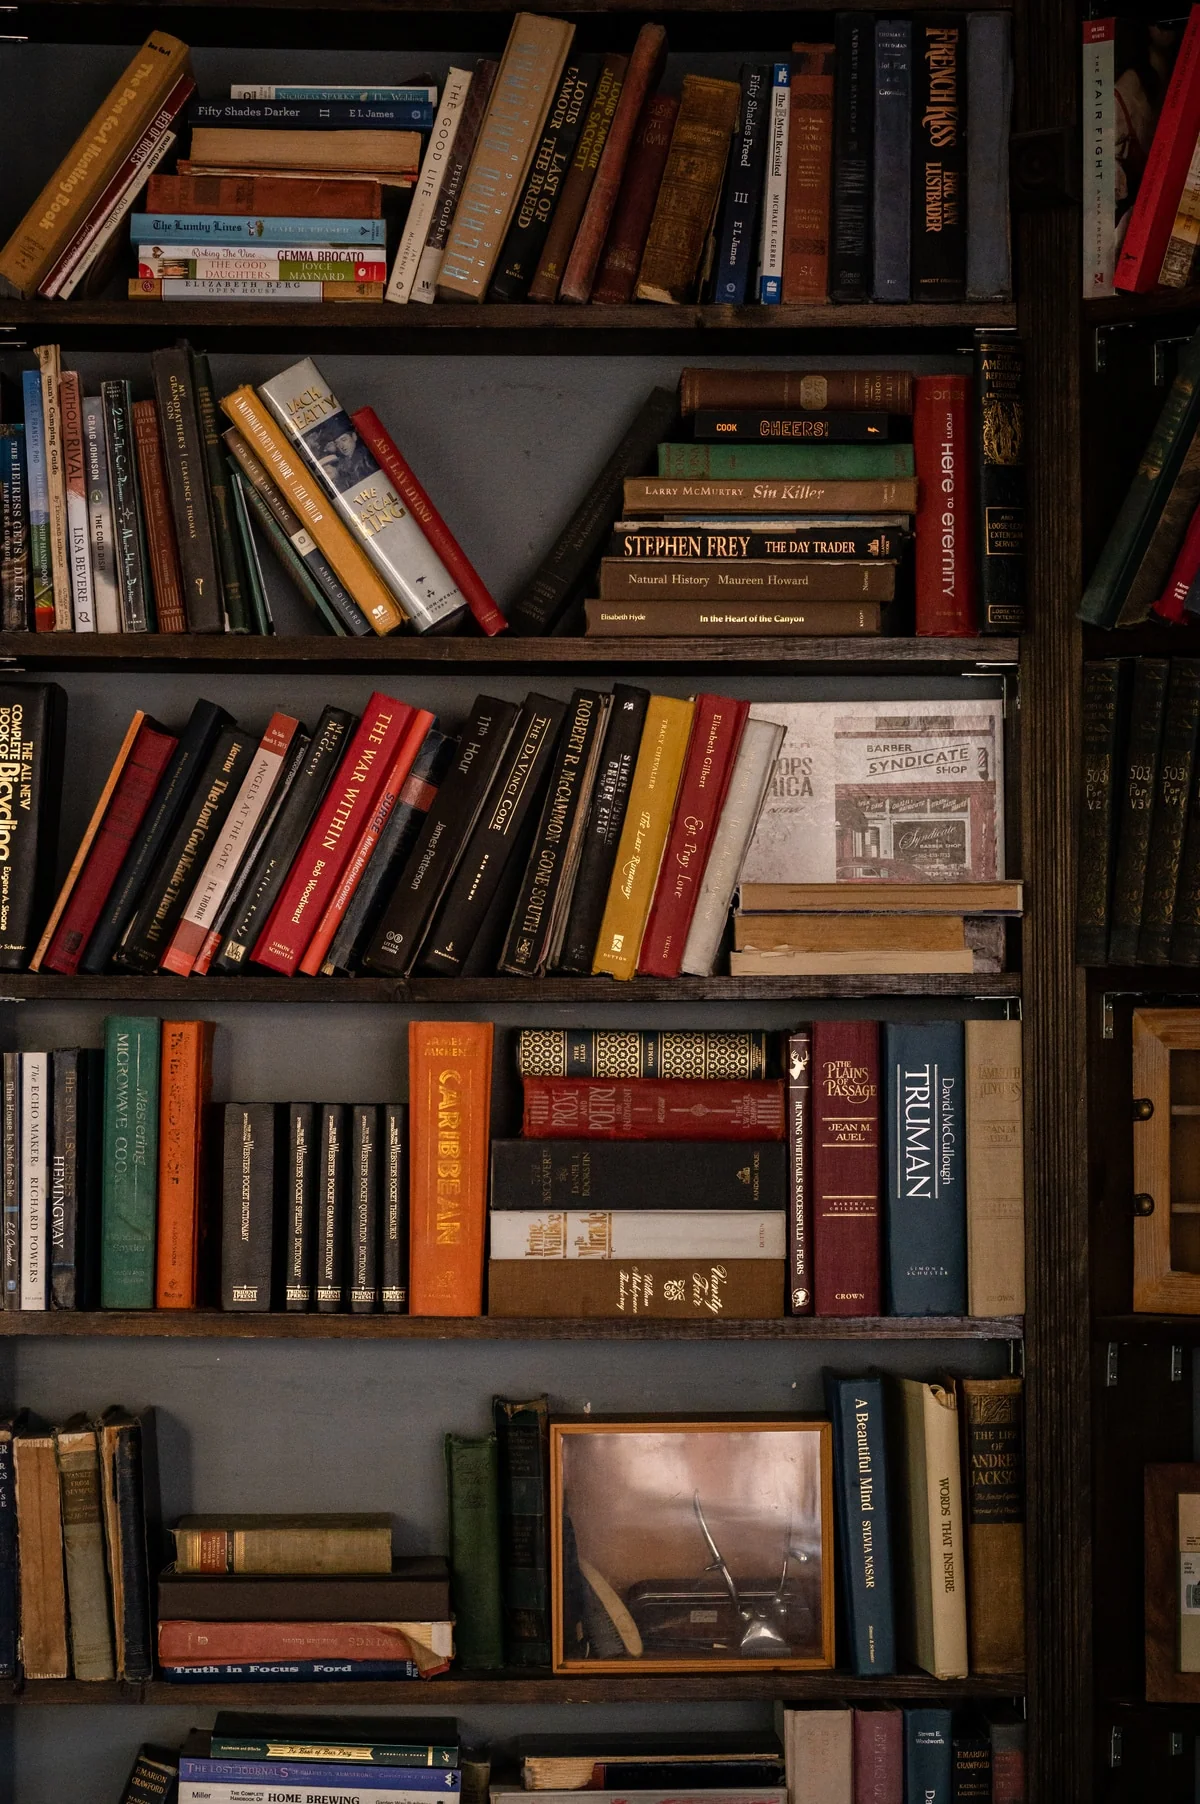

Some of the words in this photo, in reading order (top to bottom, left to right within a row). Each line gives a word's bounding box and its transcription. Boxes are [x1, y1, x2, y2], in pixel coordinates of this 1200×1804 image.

[925, 27, 959, 101] FRENCH
[447, 84, 462, 110] THE
[550, 66, 579, 130] L'AMOUR
[747, 73, 762, 99] Fifty
[198, 106, 223, 119] Fifty
[225, 107, 262, 117] Shades
[264, 107, 300, 118] Darker
[568, 79, 588, 125] LOUIS
[155, 110, 172, 125] BED
[744, 99, 757, 137] Shades
[921, 105, 959, 148] KISS
[150, 126, 162, 142] OF
[432, 117, 452, 161] GOOD
[131, 141, 153, 166] ROSES
[536, 136, 551, 171] THE
[740, 138, 751, 167] Freed
[1095, 128, 1103, 179] FIGHT
[422, 169, 434, 197] LIFE
[548, 151, 567, 192] LAST
[942, 171, 959, 200] ERIC
[516, 173, 541, 229] BREED
[536, 198, 551, 223] OF
[734, 192, 749, 204] III
[925, 162, 943, 233] LUSTBADER
[152, 220, 173, 232] The
[175, 221, 211, 234] Lumby
[213, 221, 242, 232] Lines
[942, 201, 958, 226] VAN
[206, 260, 230, 270] THE
[234, 260, 267, 270] GOOD
[277, 250, 315, 262] GEMMA
[318, 251, 364, 262] BROCATO
[301, 262, 332, 271] JOYCE
[205, 269, 270, 279] DAUGHTERS
[289, 271, 345, 281] MAYNARD
[64, 378, 79, 443] WITHOUT
[237, 401, 262, 434] NATIONAL
[257, 431, 275, 452] PARTY
[270, 450, 282, 462] NO
[276, 459, 294, 480] MORE
[716, 423, 737, 432] COOK
[759, 420, 829, 437] CHEERS!
[67, 446, 82, 482] RIVAL
[12, 456, 21, 515] HEIRESS
[374, 437, 389, 454] AS
[390, 461, 406, 484] LAY
[405, 485, 432, 522] DYING
[645, 486, 680, 496] LARRY
[682, 486, 744, 496] McMURTRY
[752, 485, 778, 499] Sin
[780, 484, 825, 499] Killer
[12, 519, 22, 555] GETS
[73, 527, 84, 550] LISA
[624, 536, 701, 557] STEPHEN
[706, 536, 751, 557] FREY
[765, 541, 786, 553] THE
[789, 541, 811, 553] DAY
[813, 541, 856, 553] TRADER
[14, 566, 24, 601] DUKE
[74, 552, 87, 602] BEVERE
[628, 574, 667, 584] Natural
[671, 574, 710, 587] History
[718, 575, 764, 585] Maureen
[767, 575, 809, 585] Howard
[700, 615, 708, 623] In
[710, 615, 723, 623] the
[725, 615, 748, 623] Heart
[749, 615, 758, 623] of
[759, 615, 772, 623] the
[774, 615, 805, 625] Canyon
[11, 704, 22, 758] COMPLETE
[368, 712, 393, 744] THE
[529, 717, 546, 741] THE
[568, 698, 593, 753] ROBERT
[564, 753, 580, 766] R.
[866, 744, 912, 752] BARBER
[869, 748, 969, 774] SYNDICATE
[22, 763, 32, 781] ALL
[247, 760, 268, 800] ANGELS
[351, 750, 378, 783] WAR
[509, 762, 529, 796] VINCI
[936, 766, 967, 774] SHOP
[1087, 769, 1107, 784] 503
[1129, 765, 1151, 781] 503
[1163, 765, 1185, 781] 503
[20, 784, 31, 811] NEW
[240, 804, 250, 817] AT
[546, 768, 576, 844] McCAMMON
[229, 819, 244, 840] THE
[322, 787, 361, 851] WITHIN
[492, 799, 513, 832] CODE
[639, 811, 651, 829] The
[634, 829, 648, 851] Last
[899, 826, 956, 850] Syndicate
[216, 844, 233, 870] GATE
[312, 859, 326, 877] Bob
[535, 849, 557, 884] GONE
[622, 852, 641, 900] Runaway
[291, 874, 318, 924] Woodward
[522, 884, 547, 934] SOUTH
[116, 1032, 129, 1128] MICROWAVE
[823, 1062, 868, 1084] PLAINS
[823, 1079, 877, 1104] PASSAGE
[941, 1078, 954, 1111] David
[552, 1089, 578, 1127] PROSE
[589, 1087, 616, 1130] POETRY
[795, 1101, 803, 1140] HUNTING
[136, 1087, 148, 1165] Mastering
[828, 1123, 858, 1132] JEAN
[860, 1123, 873, 1132] M.
[835, 1133, 865, 1141] AUEL
[904, 1064, 931, 1199] TRUMAN
[437, 1069, 462, 1245] CARIBBEAN
[939, 1113, 955, 1185] McCullough
[30, 1177, 39, 1230] RICHARD
[52, 1155, 64, 1248] HEMINGWAY
[796, 1184, 804, 1242] SUCCESSFULLY
[30, 1232, 39, 1283] POWERS
[796, 1250, 805, 1275] FEARS
[855, 1399, 868, 1409] A
[855, 1412, 872, 1474] Beautiful
[859, 1477, 873, 1511] Mind
[939, 1477, 950, 1517] WORDS
[862, 1520, 873, 1556] SYLVIA
[942, 1522, 953, 1548] THAT
[864, 1555, 875, 1588] NASAR
[943, 1552, 955, 1594] INSPIRE
[173, 1665, 220, 1675] Truth
[225, 1665, 243, 1674] in
[248, 1664, 299, 1674] Focus
[312, 1663, 353, 1674] Ford
[267, 1793, 303, 1803] HOME
[306, 1794, 360, 1804] BREWING
